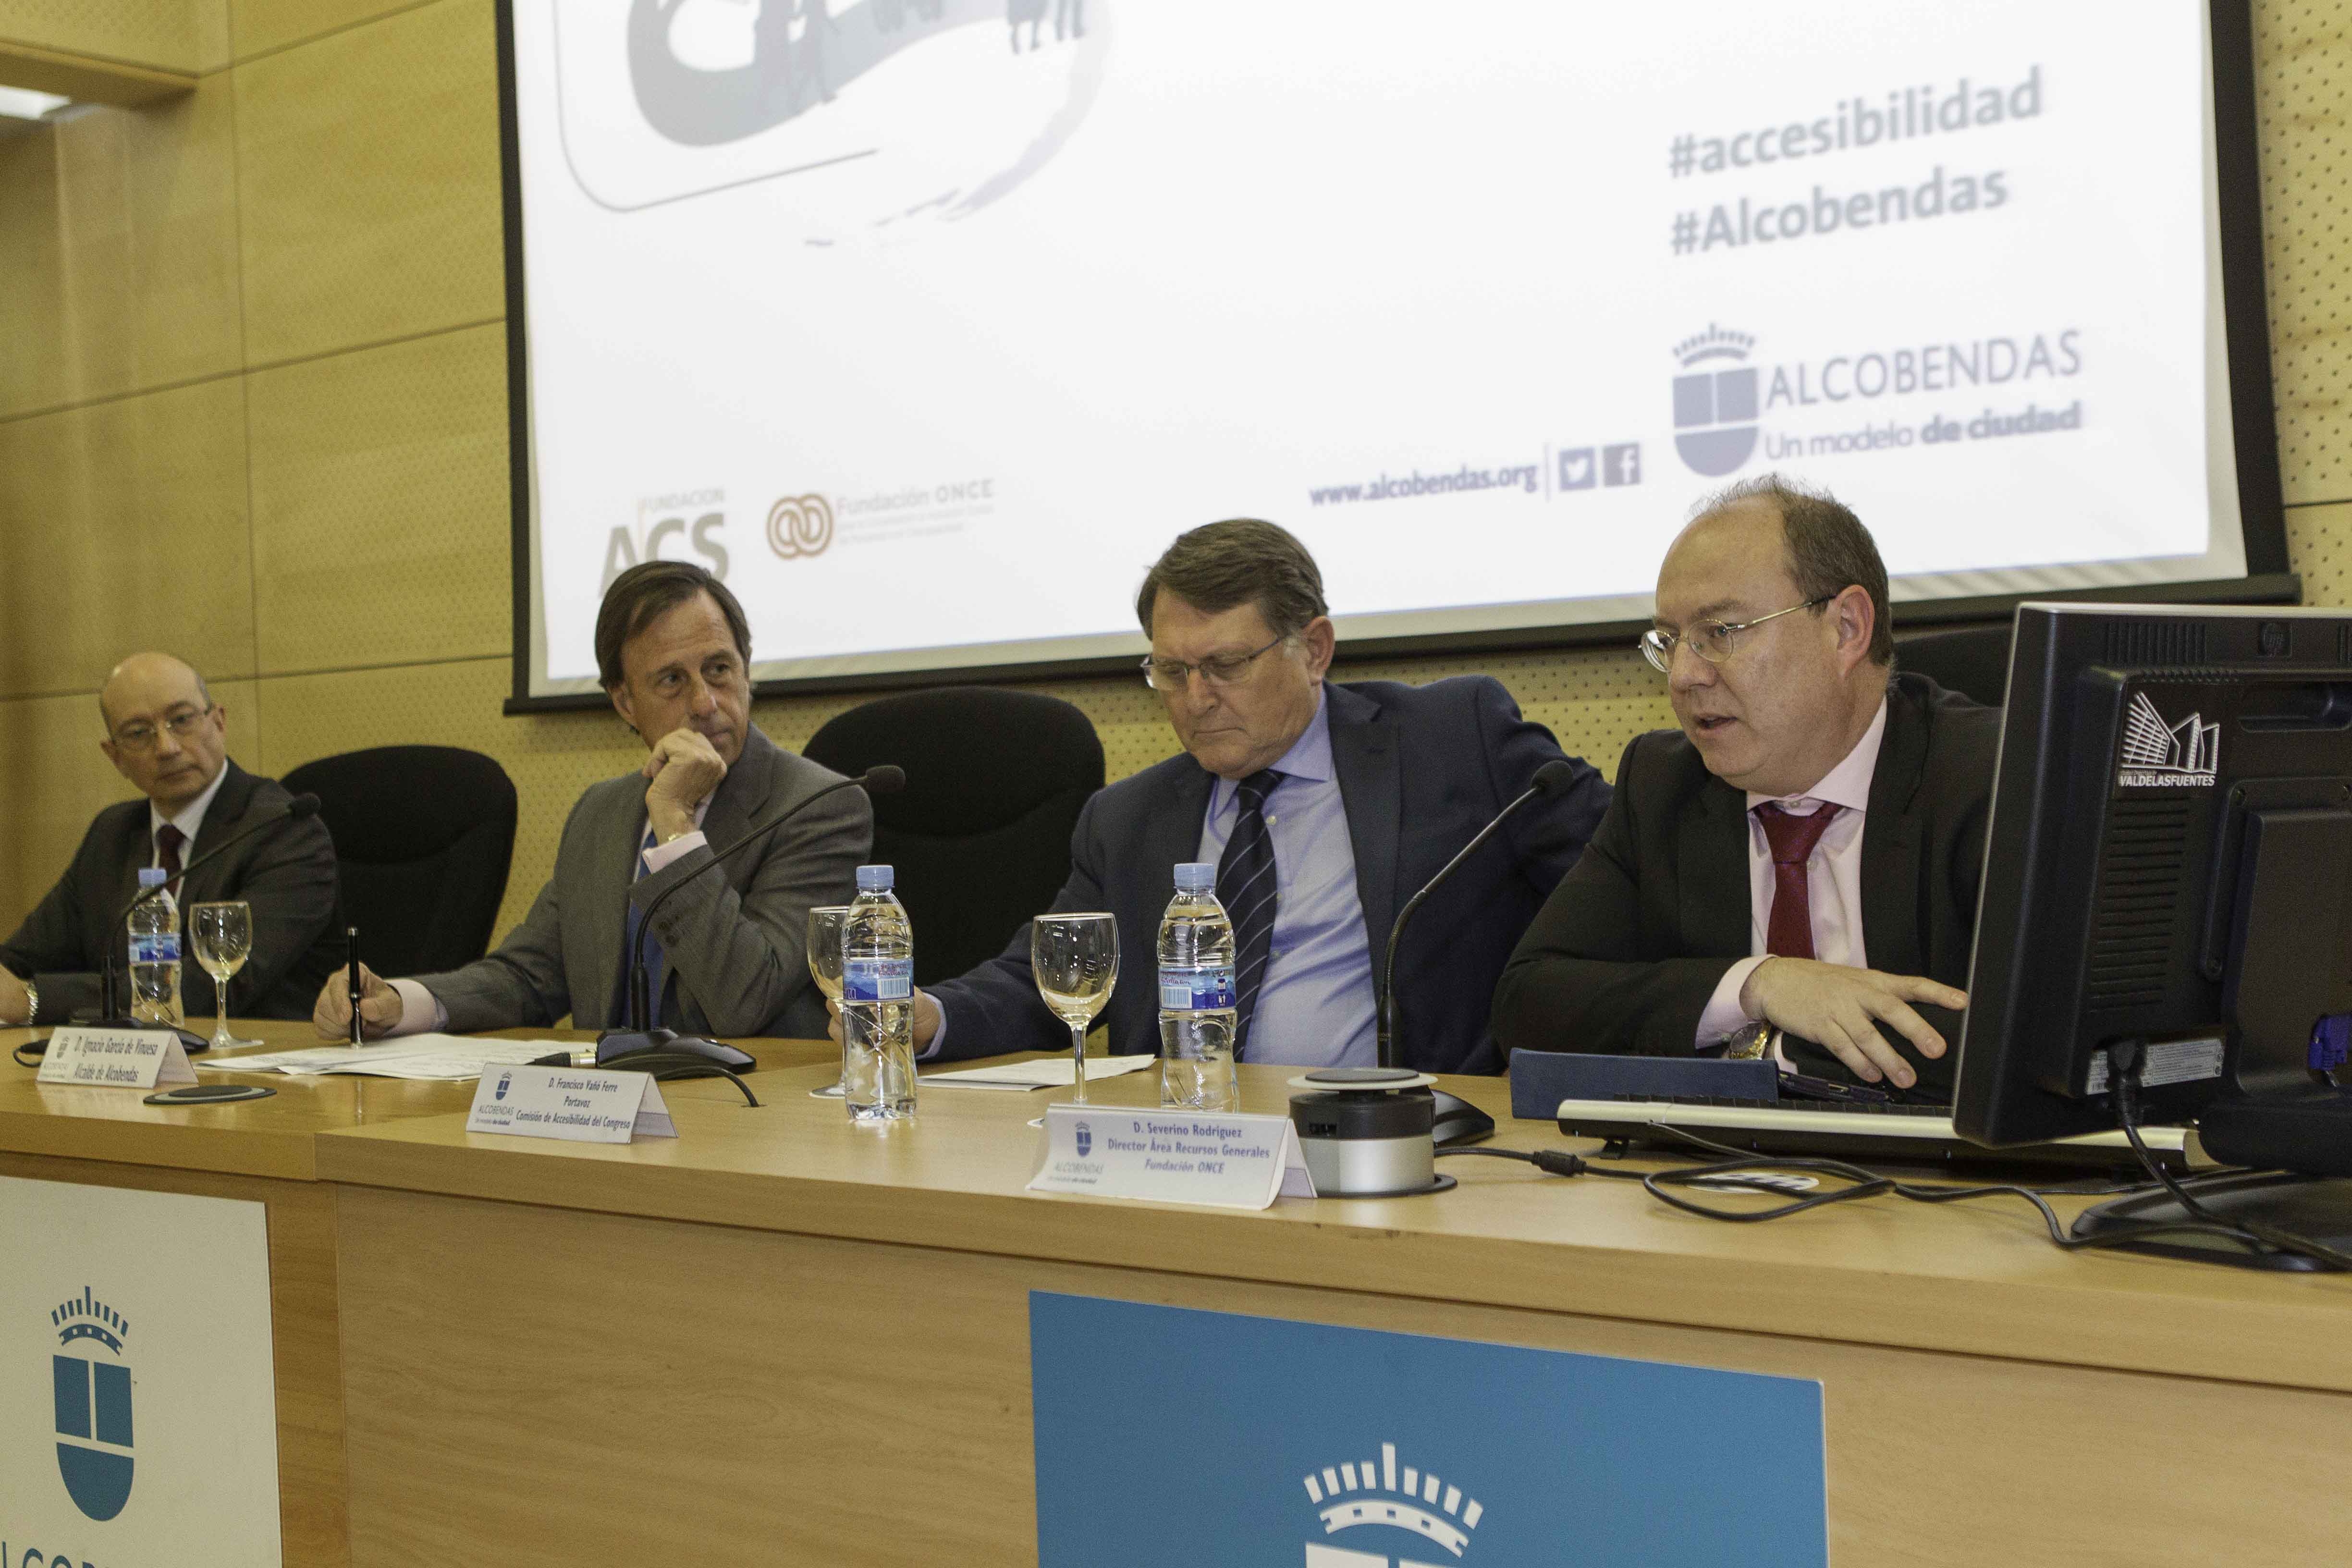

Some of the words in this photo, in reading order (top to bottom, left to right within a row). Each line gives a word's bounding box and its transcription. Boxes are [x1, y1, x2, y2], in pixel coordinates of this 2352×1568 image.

[1669, 64, 2044, 178] #accesibilidad
[1670, 165, 2009, 256] #Alcobendas
[1766, 329, 2082, 410] ALCOBENDAS
[1766, 432, 1802, 460] Un
[1811, 421, 1914, 455] modelo
[1921, 414, 1961, 444] de
[1968, 400, 2082, 439] ciudad
[935, 477, 995, 503] ONCE
[1309, 465, 1539, 507] www.alcobendas.org
[2120, 775, 2216, 787] VALDELASFUENTES
[125, 1038, 134, 1054] de
[96, 1064, 104, 1080] de
[104, 1064, 139, 1082] Alcobendas
[549, 1077, 554, 1089] D.
[556, 1078, 584, 1090] Francisco
[601, 1081, 618, 1092] Ferre
[563, 1096, 591, 1108] Portavoz
[516, 1110, 542, 1121] Comisión
[544, 1112, 551, 1123] de
[552, 1113, 591, 1126] Accesibilidad
[592, 1116, 601, 1127] del
[603, 1116, 631, 1131] Congreso
[1134, 1122, 1144, 1134] D.
[1148, 1122, 1189, 1136] Severino
[1108, 1138, 1146, 1152] Director
[1176, 1142, 1218, 1156] Recursos
[1222, 1144, 1270, 1159] Generales
[1145, 1158, 1194, 1172] Fundación
[1198, 1161, 1225, 1175] ONCE
